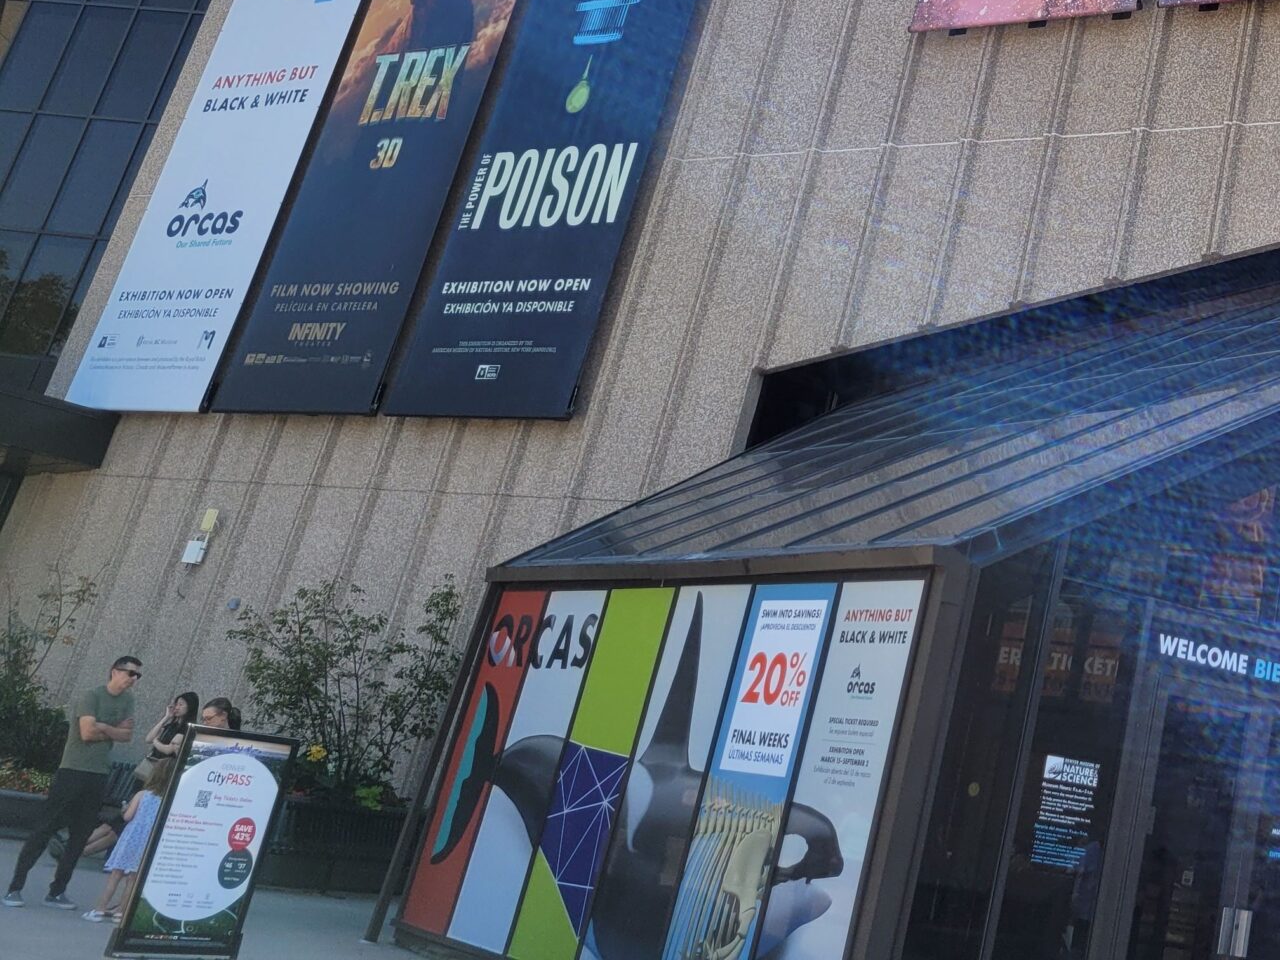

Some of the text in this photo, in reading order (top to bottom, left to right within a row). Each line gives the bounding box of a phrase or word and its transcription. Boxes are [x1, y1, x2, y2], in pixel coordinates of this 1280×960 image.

[212, 65, 319, 90] ANYTHING BUT
[358, 43, 472, 127] T.REX
[203, 88, 309, 113] BLACK & WHITE
[369, 137, 403, 170] 3D
[458, 153, 492, 231] THE POWER OF
[471, 142, 638, 230] POISON
[166, 209, 244, 238] orcas
[271, 281, 400, 298] FILM NOW SHOWING
[442, 278, 591, 294] EXHIBITION NOW OPEN
[119, 288, 234, 302] EXHIBITION NOW OPEN
[117, 306, 219, 319] EXHIBICIÓN YA DISPONIBLE
[274, 301, 378, 312] PELÍCULA EN CARTELERA
[444, 300, 575, 314] EXHIBICIÓN YA DISPONIBLE
[288, 322, 347, 340] INFINITY
[761, 609, 822, 618] SWIM INTO SAVINGS!
[844, 608, 913, 623] ANYTHING BUT
[488, 613, 599, 670] ORCAS
[839, 630, 908, 644] BLACK & WHITE
[1159, 633, 1249, 675] WELCOME
[740, 651, 808, 706] 20%
[847, 681, 876, 695] orcas
[780, 690, 801, 707] OFF
[731, 728, 790, 749] FINAL WEEKS
[753, 749, 784, 765] SEMANAS
[207, 770, 252, 787] CityPASS
[1063, 763, 1094, 777] NATURE
[1062, 773, 1098, 787] SCIENCE
[234, 824, 254, 833] SAVE
